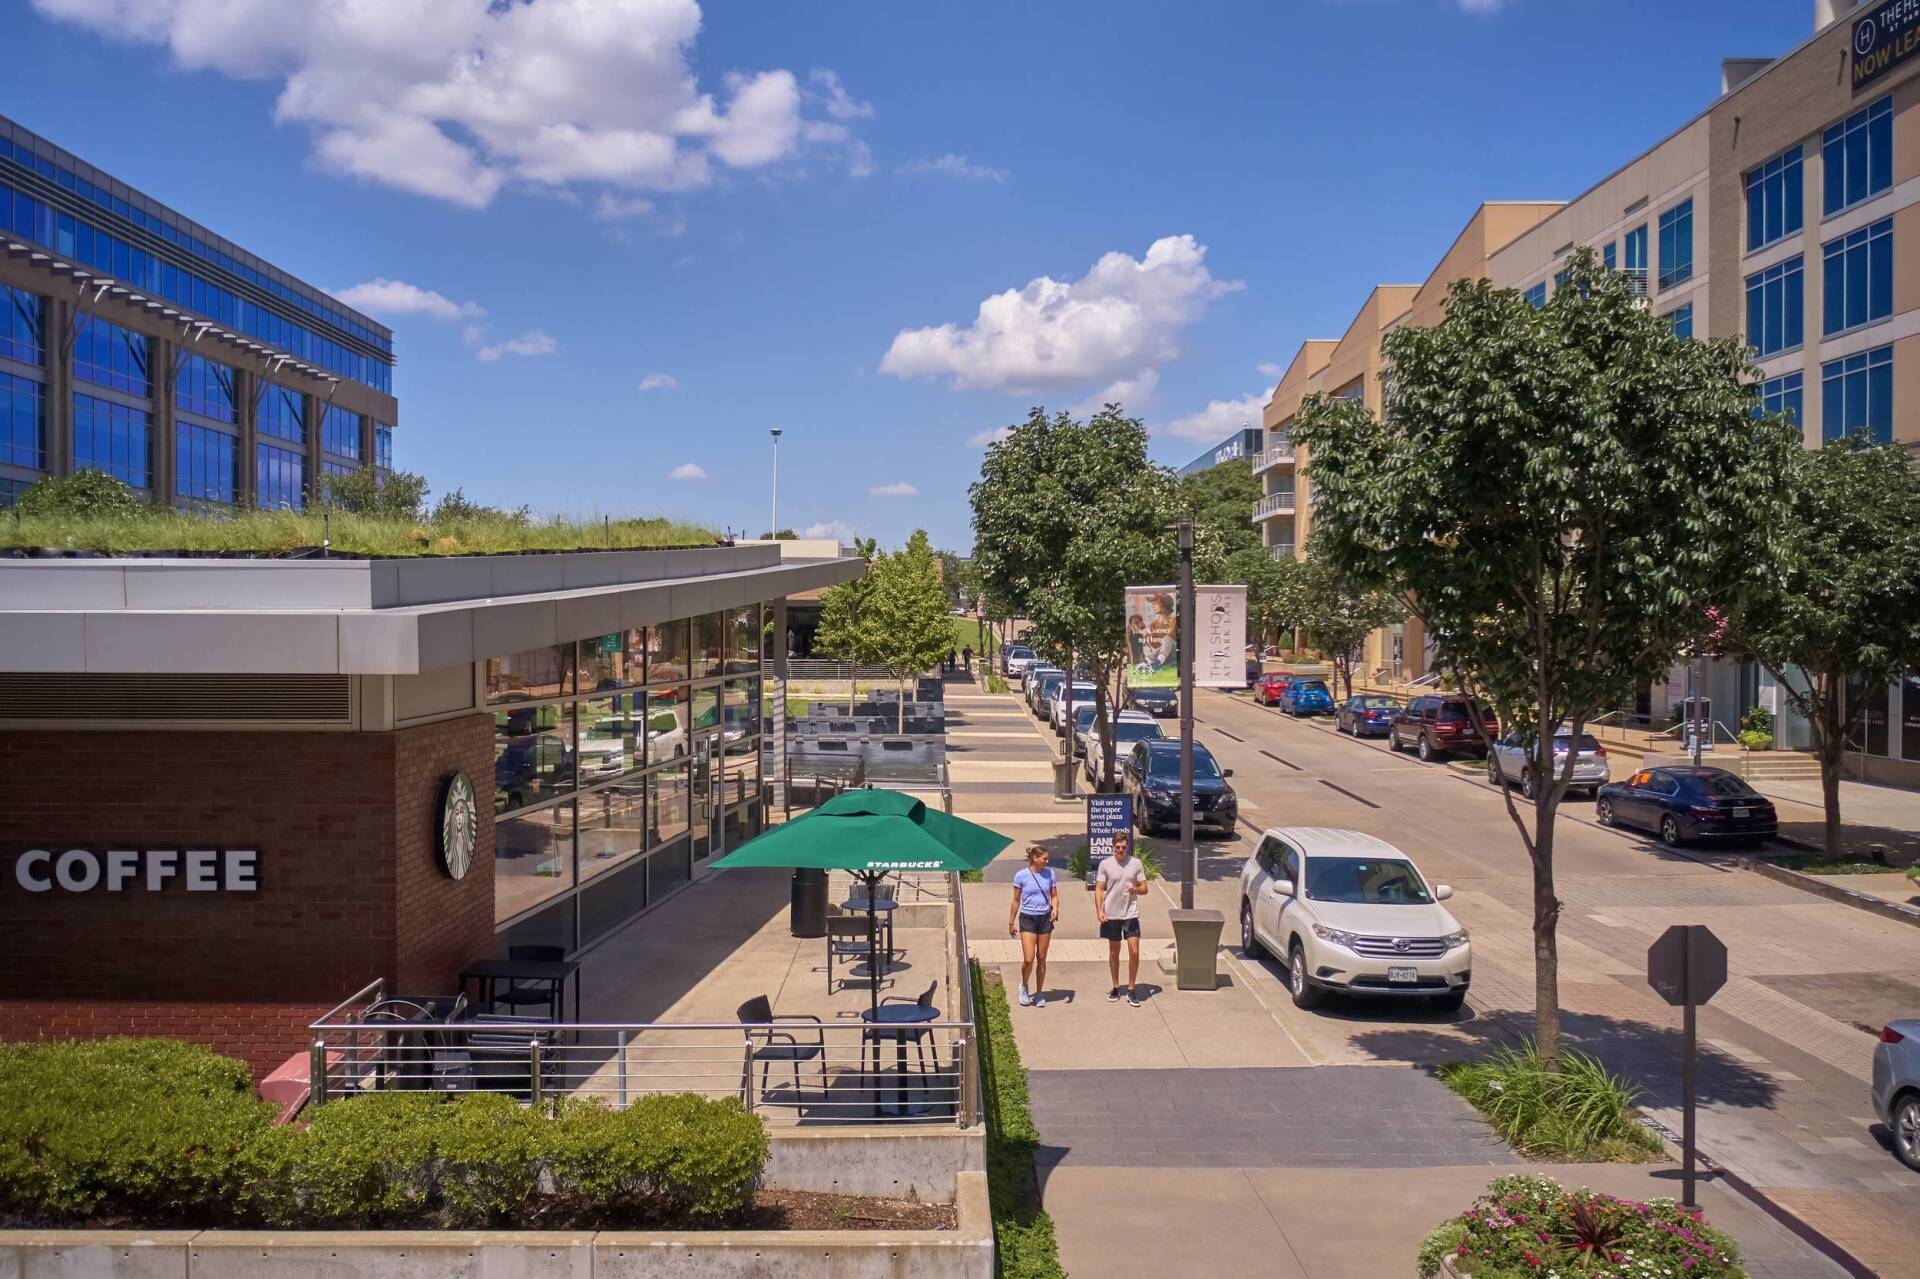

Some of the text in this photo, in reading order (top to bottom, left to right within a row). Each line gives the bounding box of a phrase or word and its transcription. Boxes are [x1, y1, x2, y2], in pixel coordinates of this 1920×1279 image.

[1880, 2, 1902, 28] THE
[1889, 23, 1899, 32] AT
[1854, 43, 1892, 82] NOW
[15, 849, 257, 893] COFFEE
